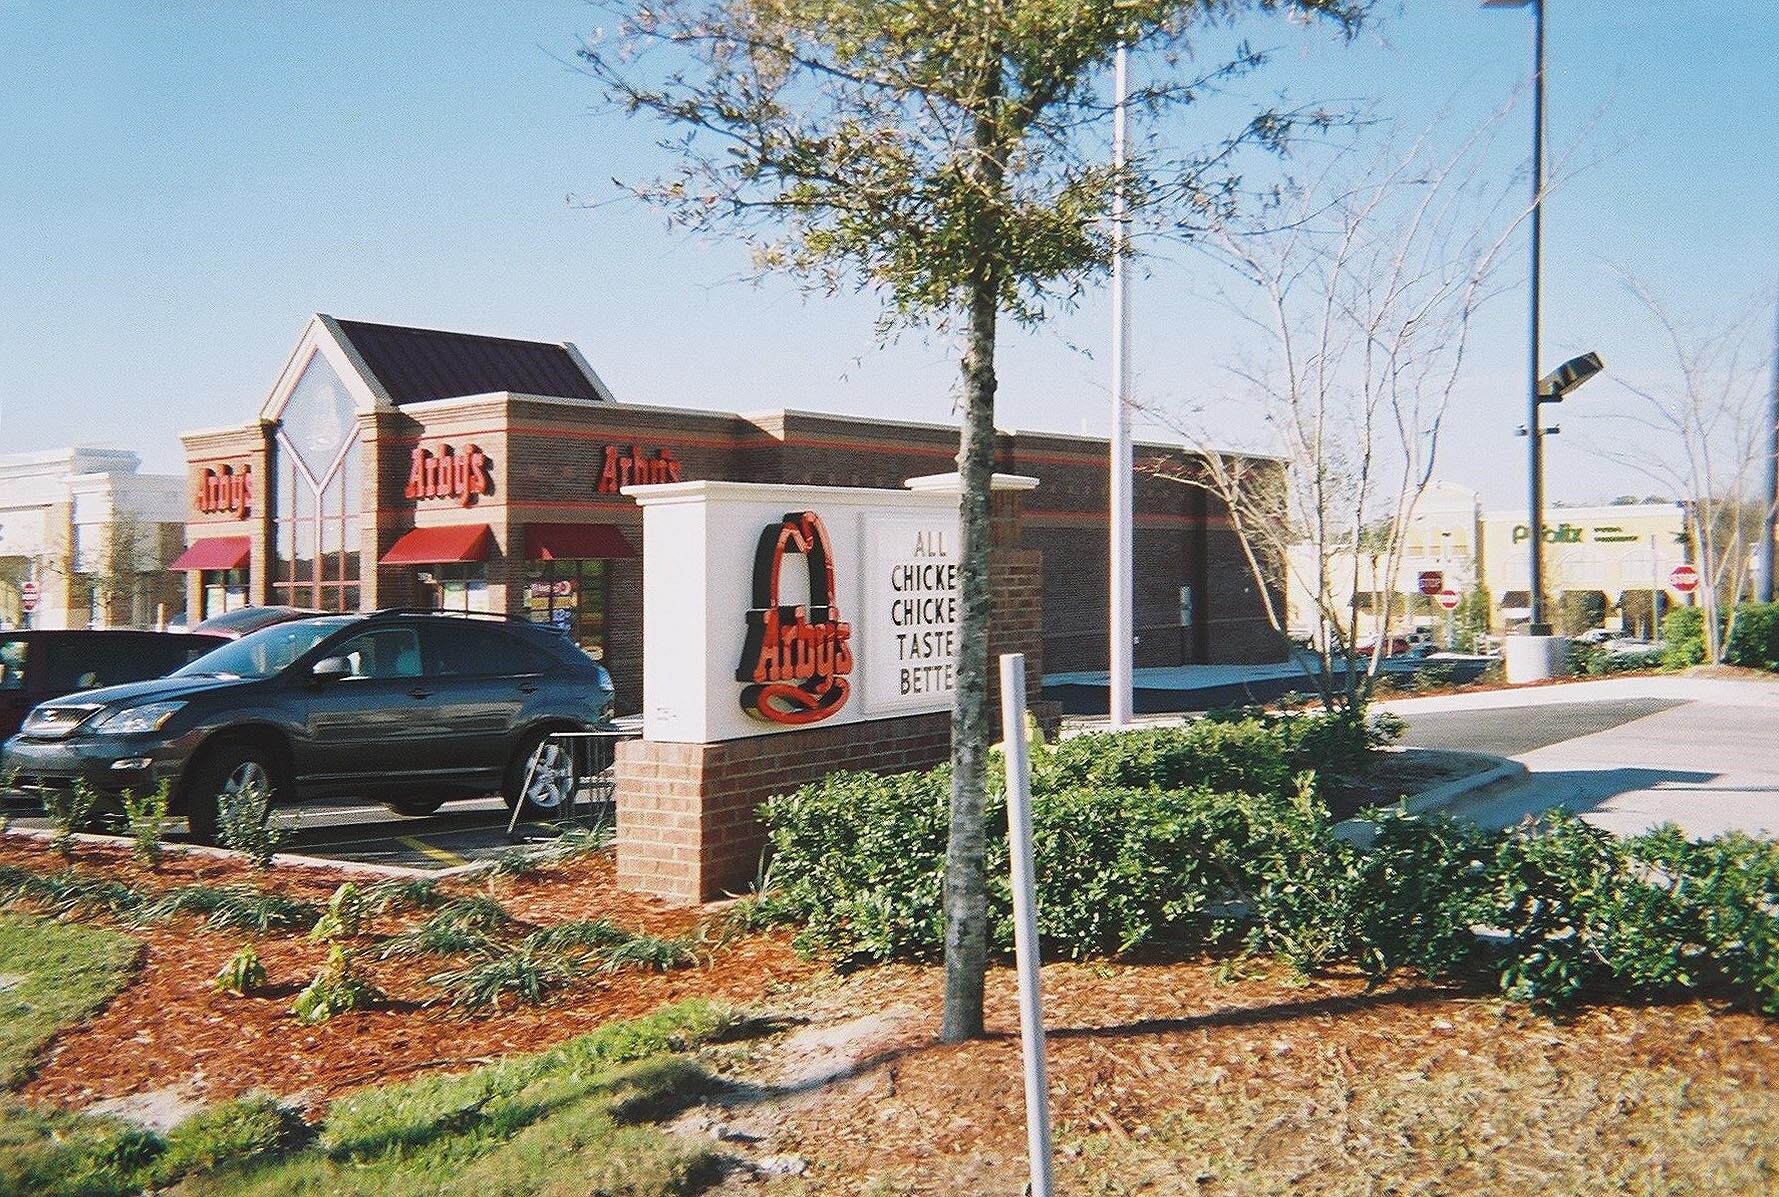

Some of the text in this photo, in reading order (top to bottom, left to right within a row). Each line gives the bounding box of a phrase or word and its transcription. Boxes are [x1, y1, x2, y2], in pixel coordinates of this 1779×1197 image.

[405, 443, 490, 508] Arby's
[194, 464, 253, 519] Arby's
[914, 531, 947, 557] ALL
[892, 564, 957, 592] CHICKE
[892, 597, 957, 626] CHICKE
[753, 606, 853, 694] Arby's
[896, 630, 955, 660] TASTE
[899, 664, 954, 696] BETTE
